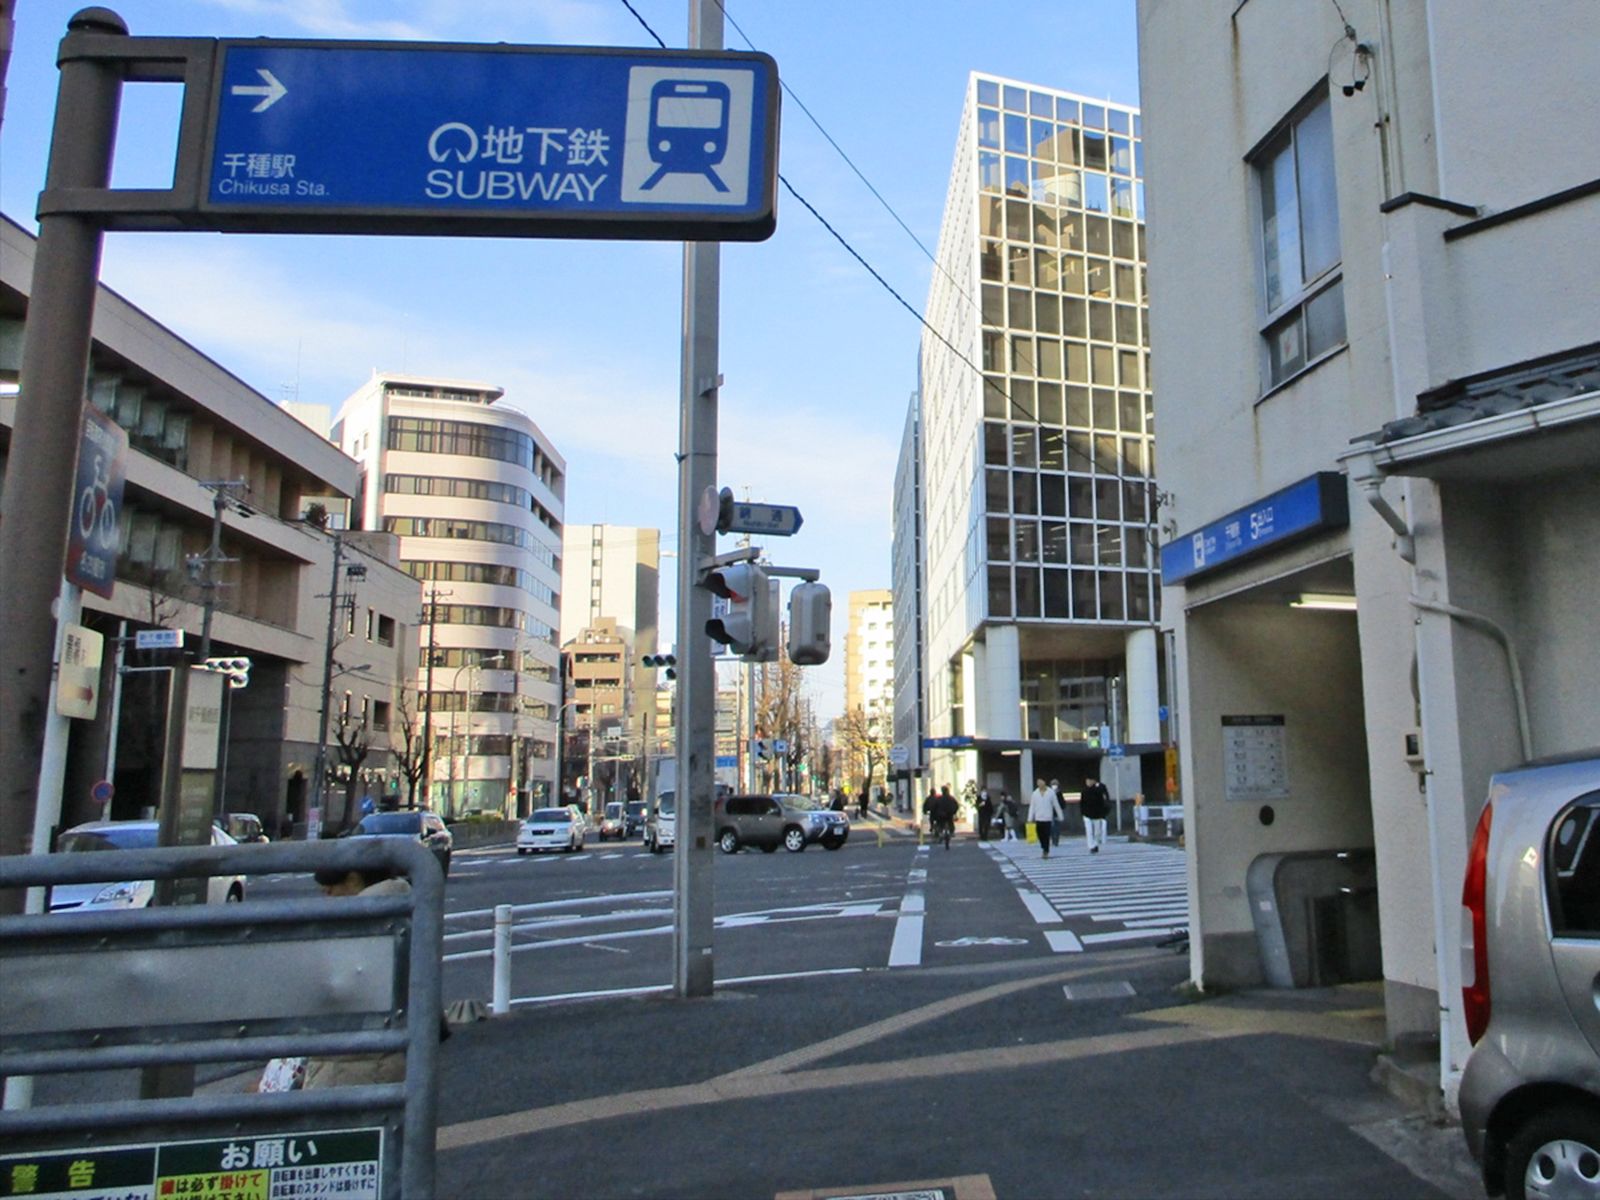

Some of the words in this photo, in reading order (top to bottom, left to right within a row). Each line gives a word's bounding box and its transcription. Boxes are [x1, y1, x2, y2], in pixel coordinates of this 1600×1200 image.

[481, 125, 610, 167] 地下鉄
[222, 153, 297, 179] 千種駅
[218, 178, 290, 195] Chikusa
[295, 179, 331, 197] Sta.
[424, 168, 608, 202] SUBWAY
[220, 1140, 319, 1170] お願い
